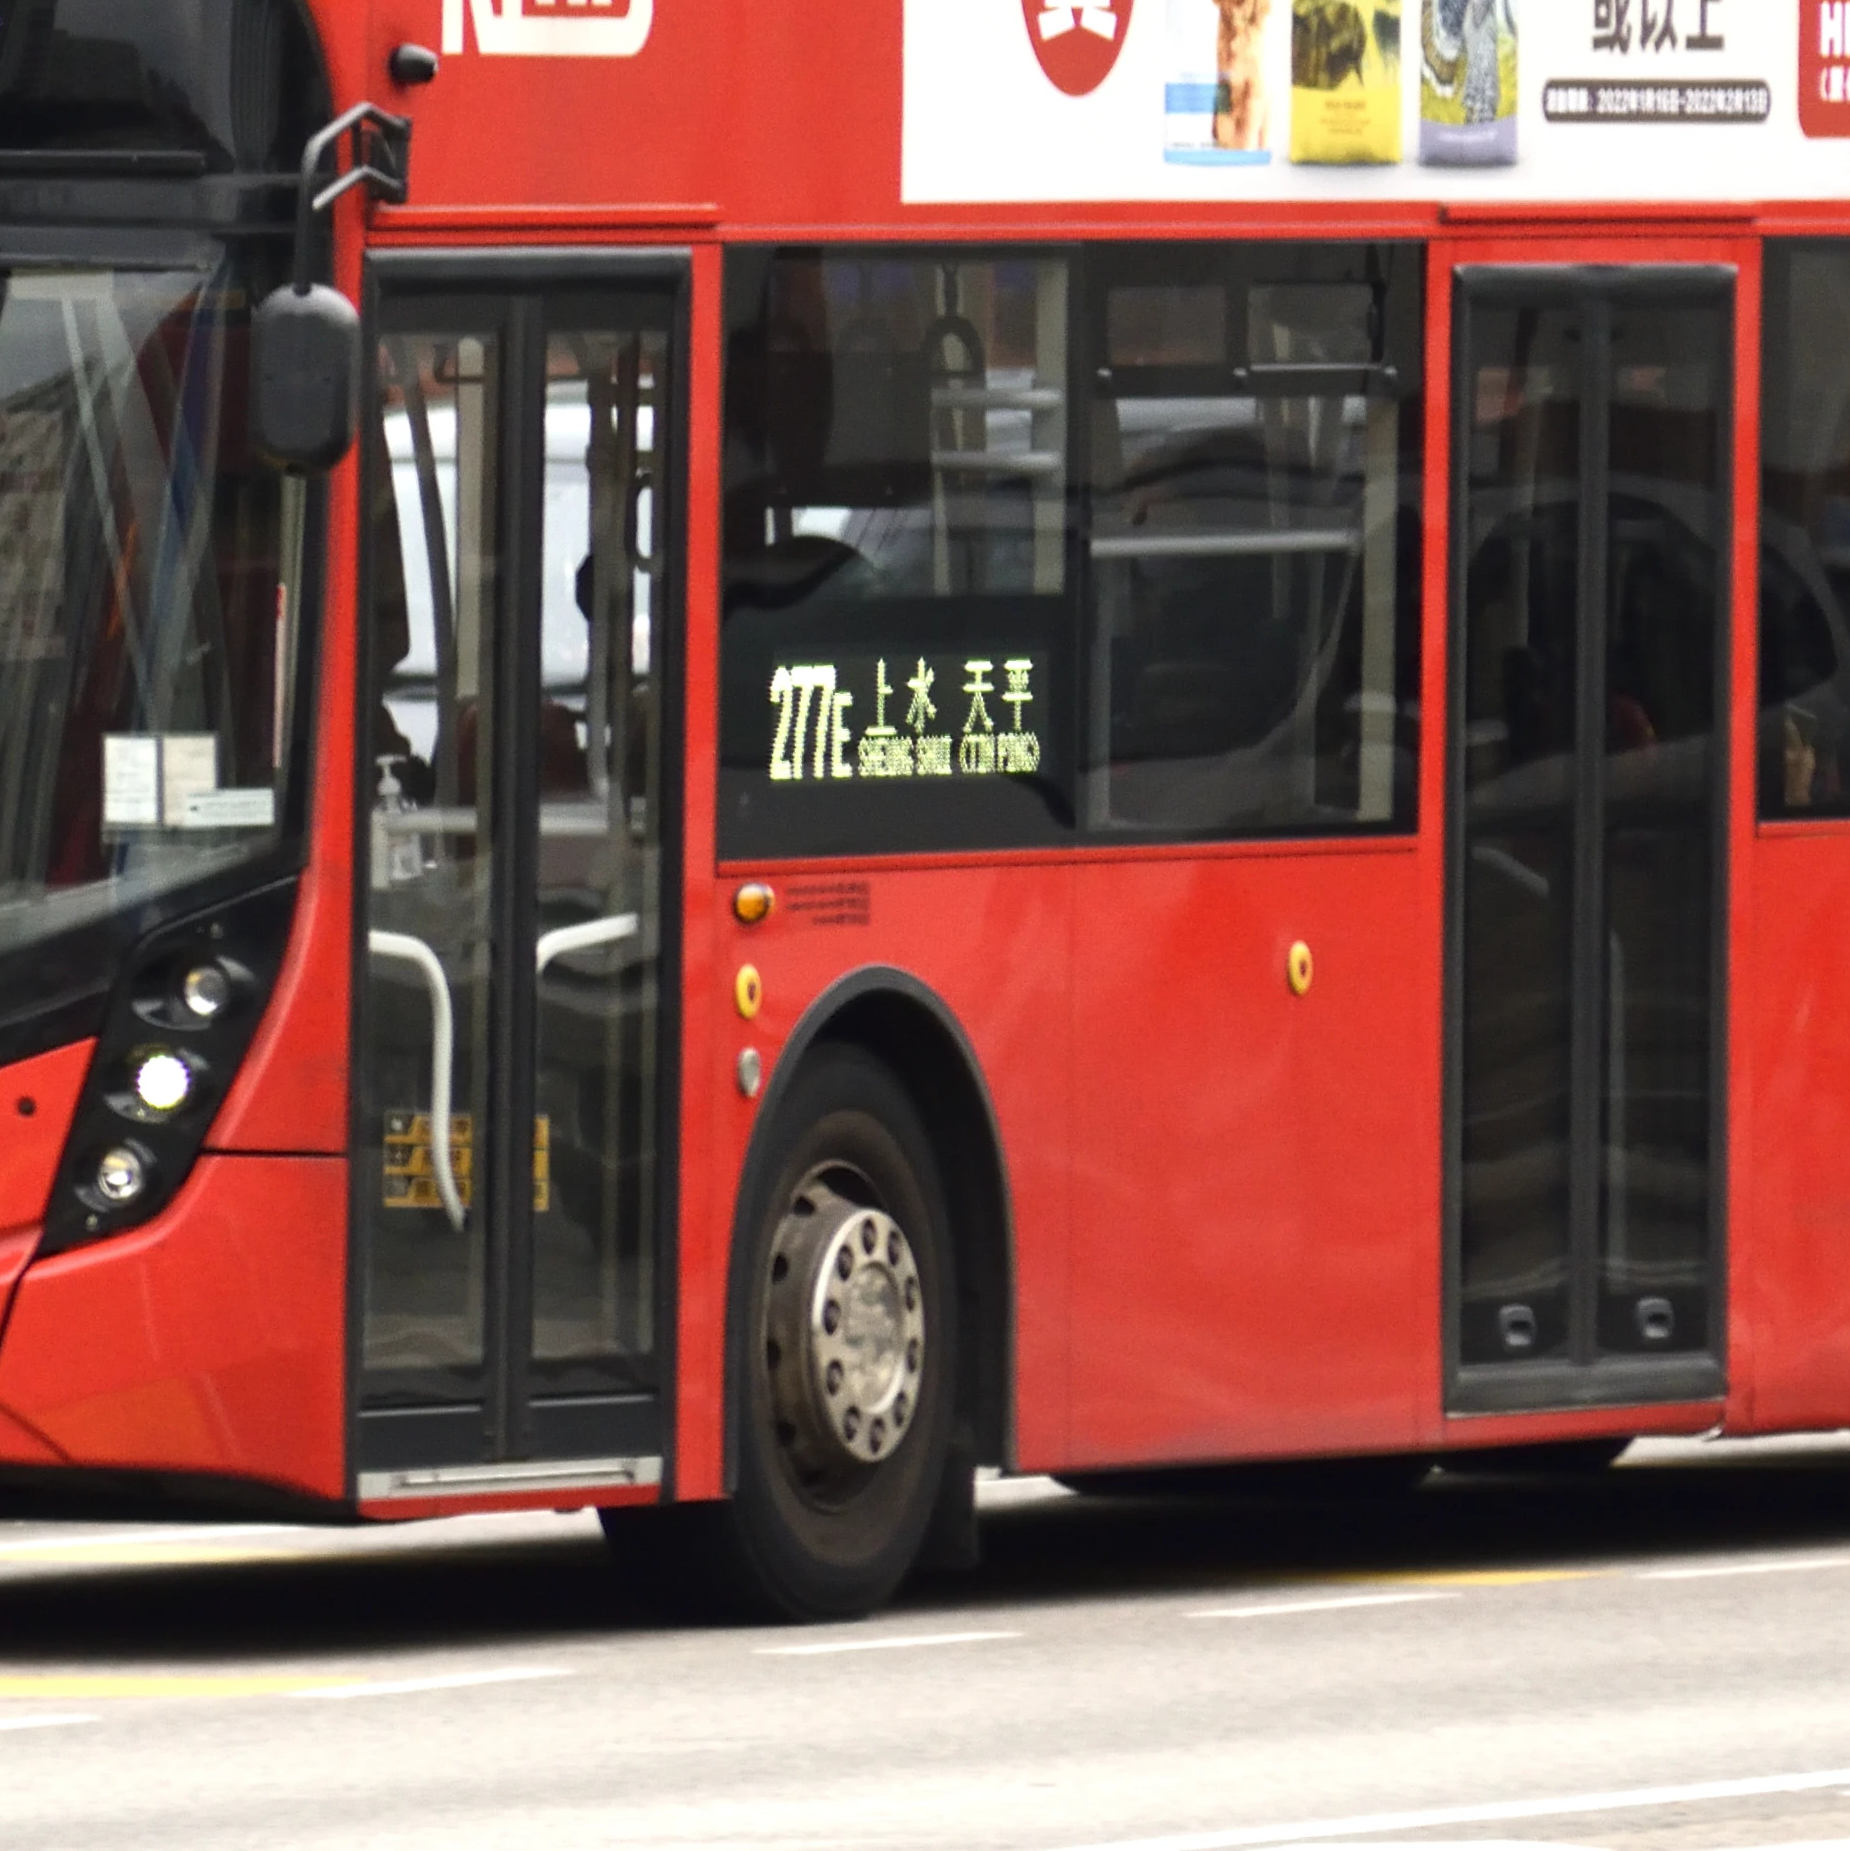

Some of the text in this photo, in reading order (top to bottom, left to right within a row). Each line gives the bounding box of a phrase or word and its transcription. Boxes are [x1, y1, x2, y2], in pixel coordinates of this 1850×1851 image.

[769, 662, 853, 780] 277E
[863, 656, 1035, 737] 上水 天平
